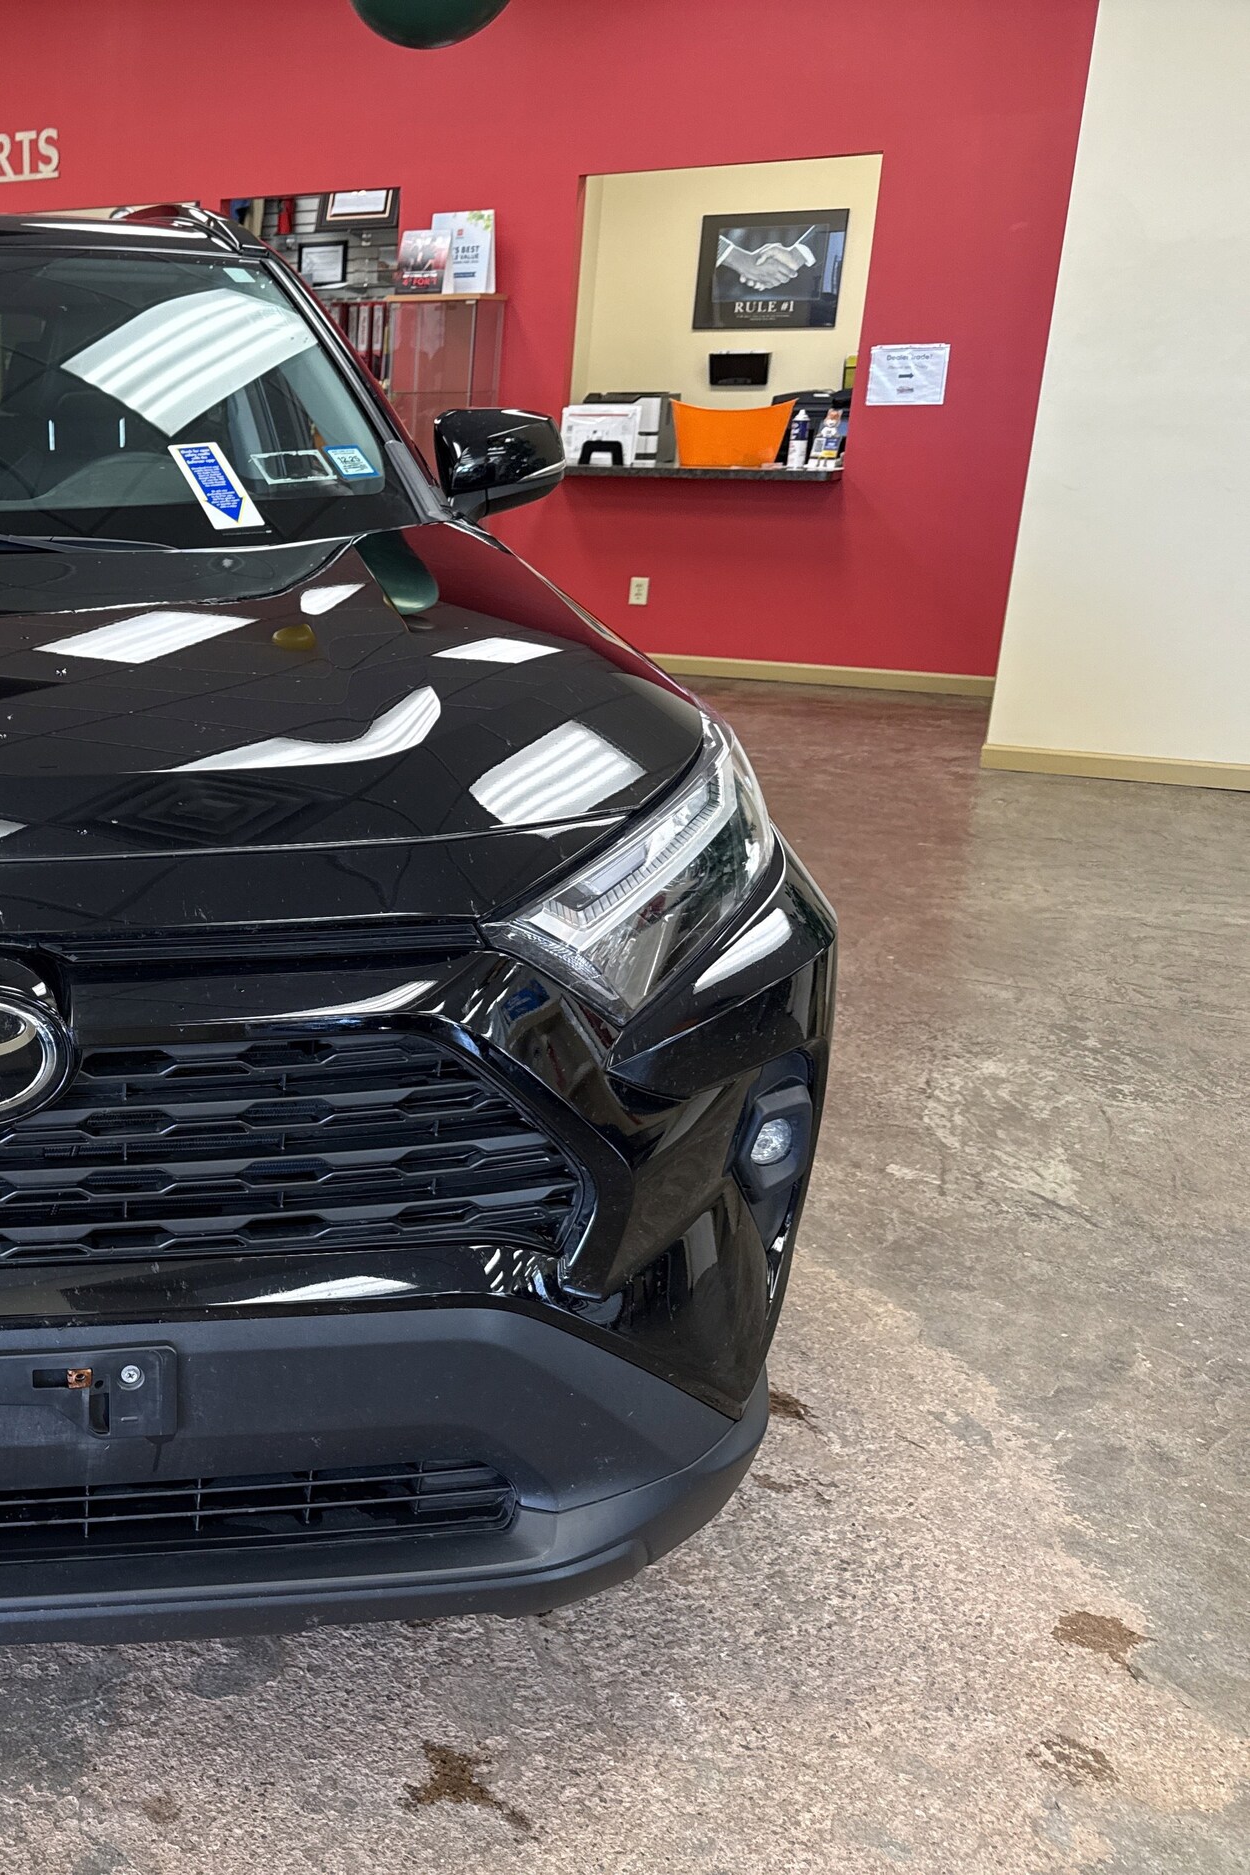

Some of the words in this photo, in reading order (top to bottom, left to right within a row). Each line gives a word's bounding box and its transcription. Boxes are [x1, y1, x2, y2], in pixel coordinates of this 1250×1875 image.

[461, 244, 480, 253] BEST
[734, 301, 778, 313] RULE
[780, 300, 795, 312] #1
